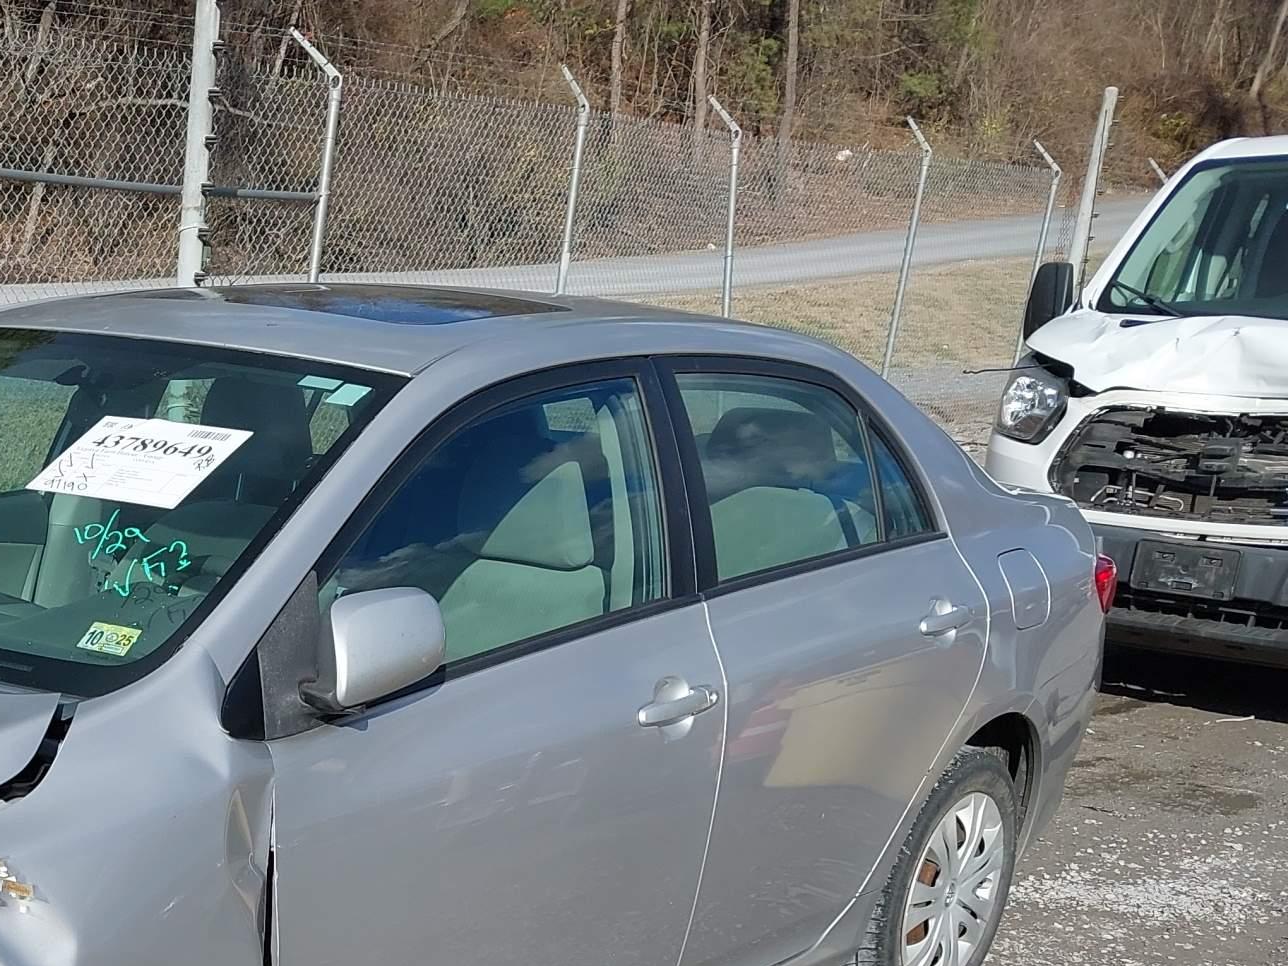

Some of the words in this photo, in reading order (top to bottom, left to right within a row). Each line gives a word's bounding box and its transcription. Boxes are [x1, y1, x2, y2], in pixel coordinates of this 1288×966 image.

[92, 433, 213, 460] 43789649
[84, 629, 105, 646] 10
[115, 634, 135, 647] 25
